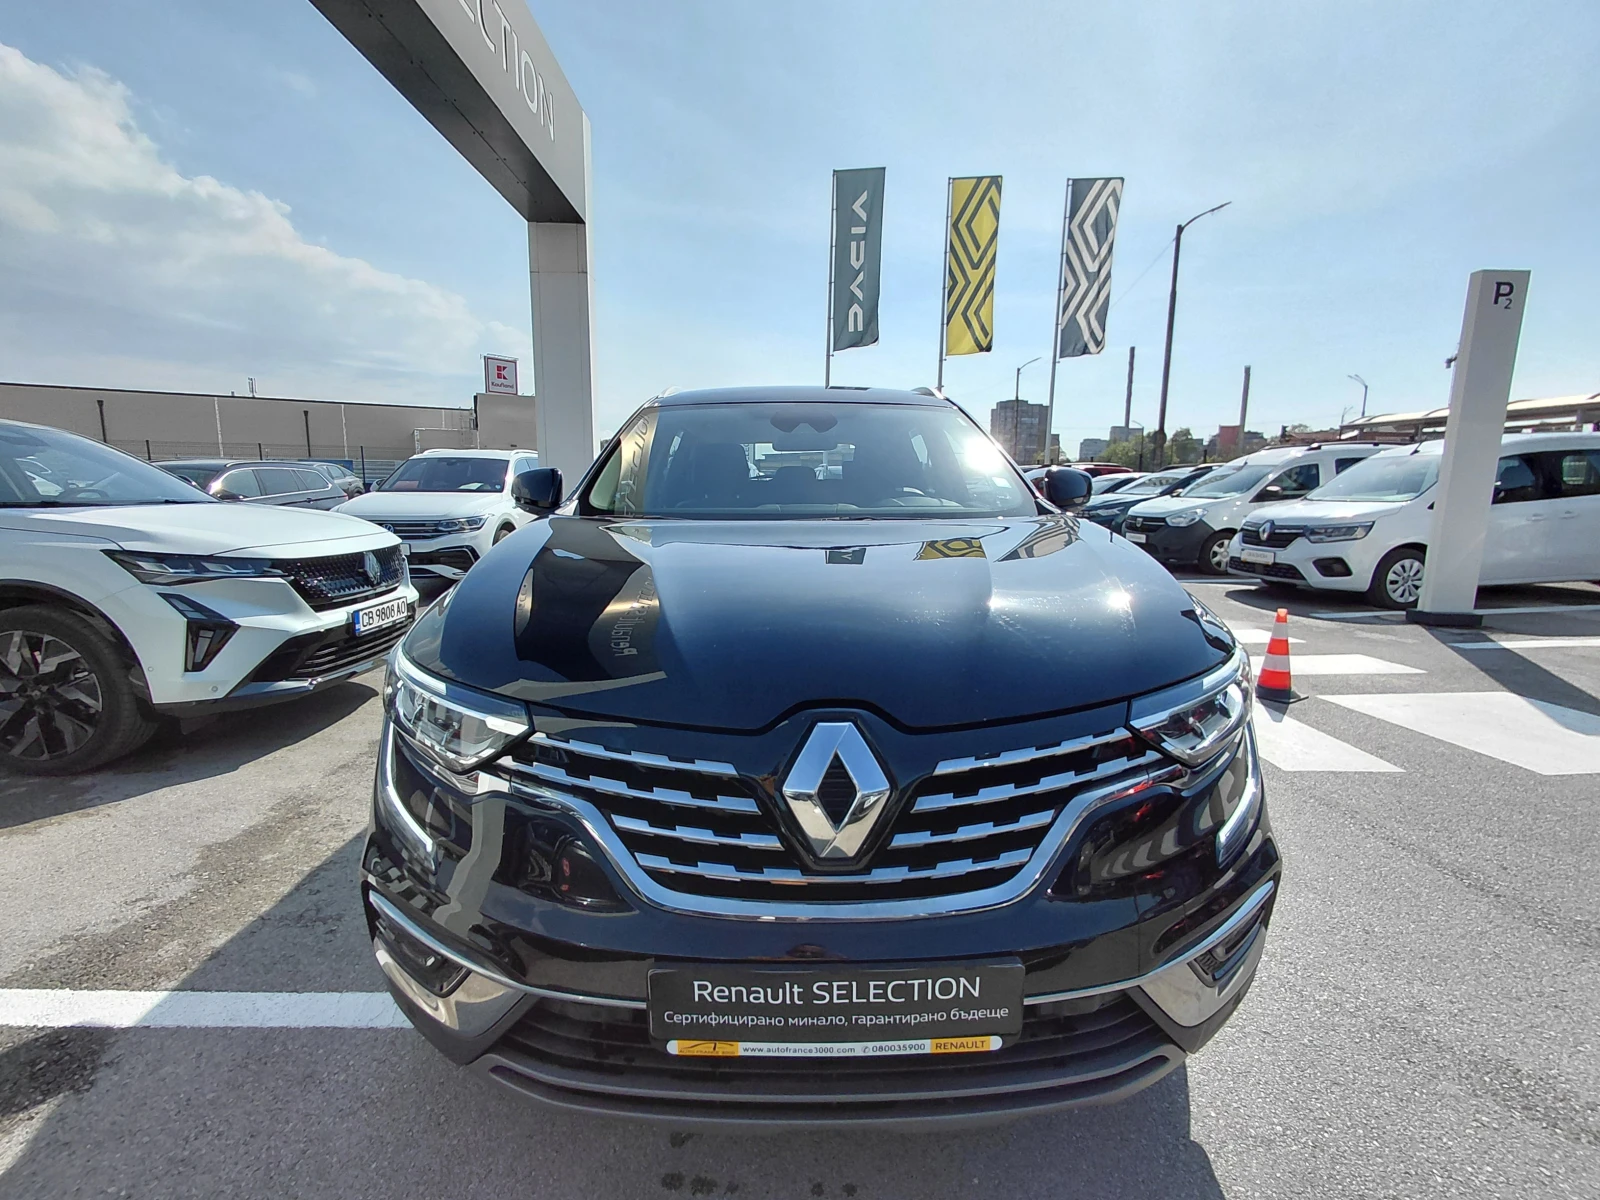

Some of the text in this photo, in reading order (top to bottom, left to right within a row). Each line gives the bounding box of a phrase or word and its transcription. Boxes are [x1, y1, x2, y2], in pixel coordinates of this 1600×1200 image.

[457, 0, 555, 142] CTION
[848, 190, 868, 332] DACIA
[362, 610, 374, 627] CB
[376, 604, 395, 624] 9808
[693, 976, 980, 1004] Renault SELECTION
[664, 1007, 1009, 1027] Сертифицирано минало, гарантирано бъдеще
[742, 1043, 926, 1055] www.autofrance3000.com 080035900
[935, 1040, 987, 1051] RENAULT
